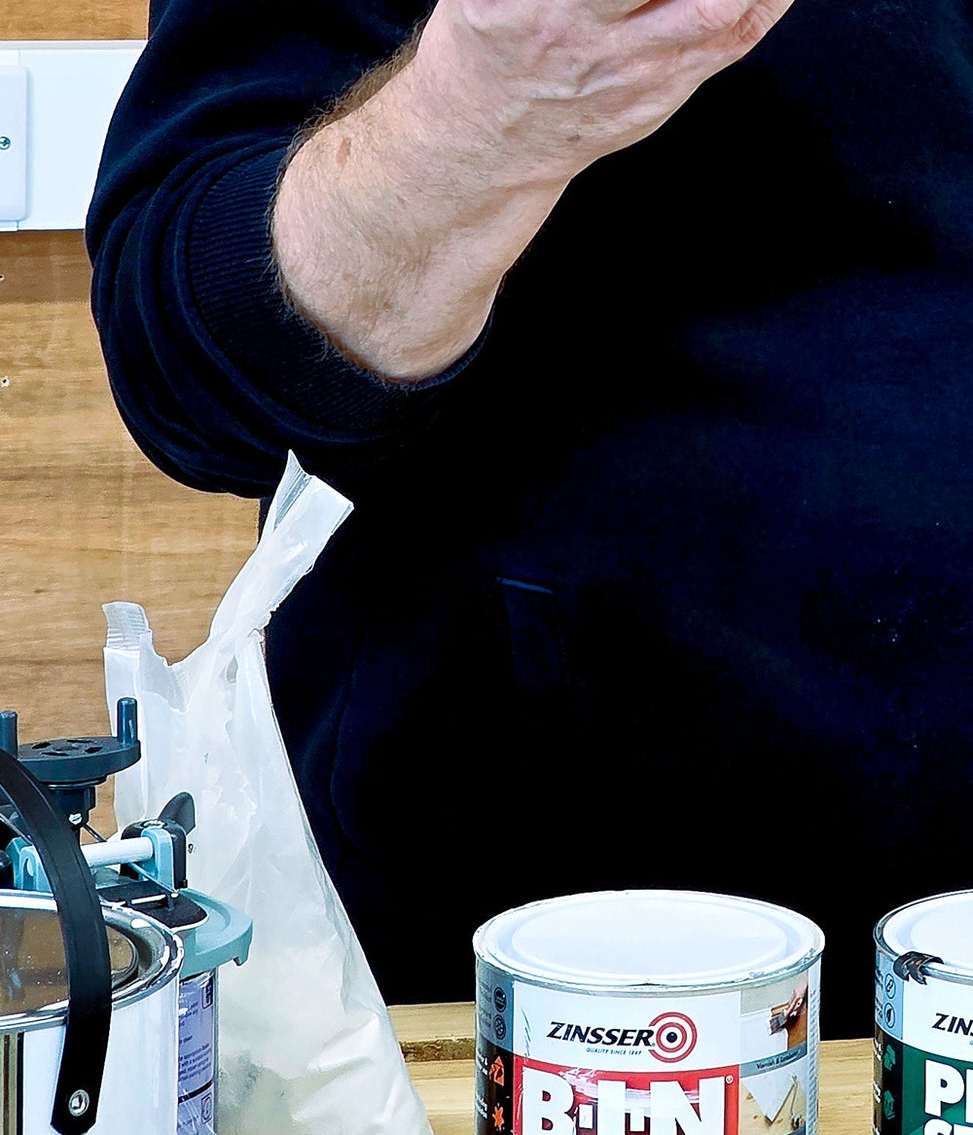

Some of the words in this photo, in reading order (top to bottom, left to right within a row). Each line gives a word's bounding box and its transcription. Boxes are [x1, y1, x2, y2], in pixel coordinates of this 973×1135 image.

[546, 1021, 655, 1047] ZINSSER
[586, 1046, 609, 1054] QUALITY
[610, 1048, 627, 1056] SINCE
